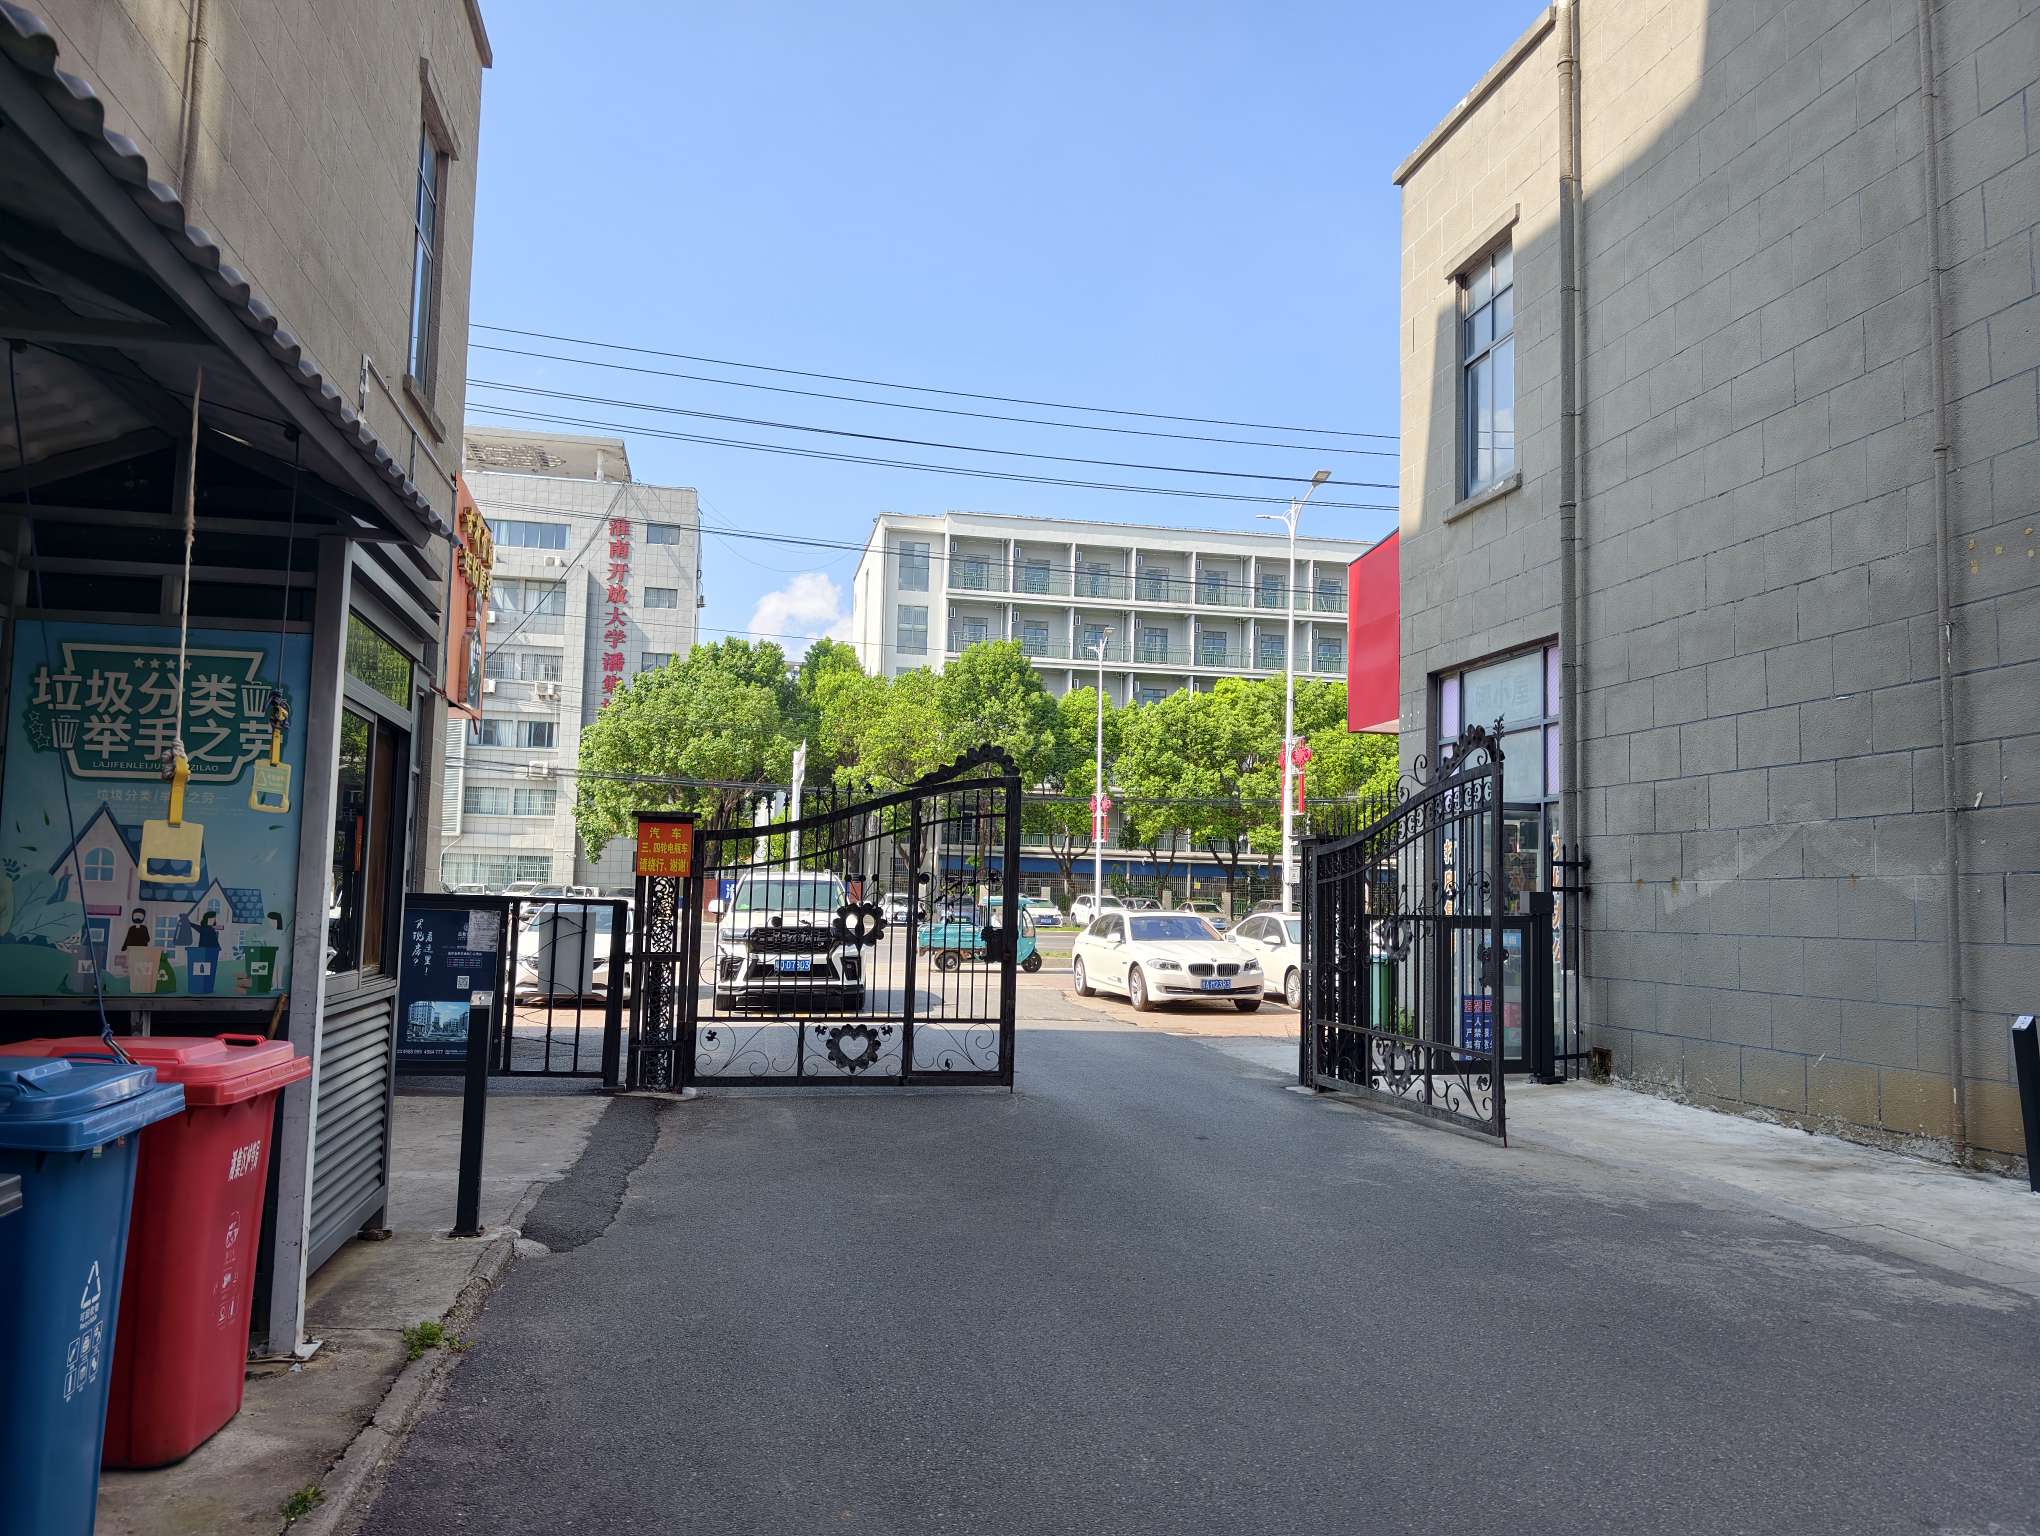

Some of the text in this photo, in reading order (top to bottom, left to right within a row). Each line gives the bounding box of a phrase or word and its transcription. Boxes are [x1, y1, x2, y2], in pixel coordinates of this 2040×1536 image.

[601, 517, 631, 709] 淮南开放大学潘集
[32, 666, 237, 719] 垃圾分类
[82, 714, 283, 763] 举手之劳
